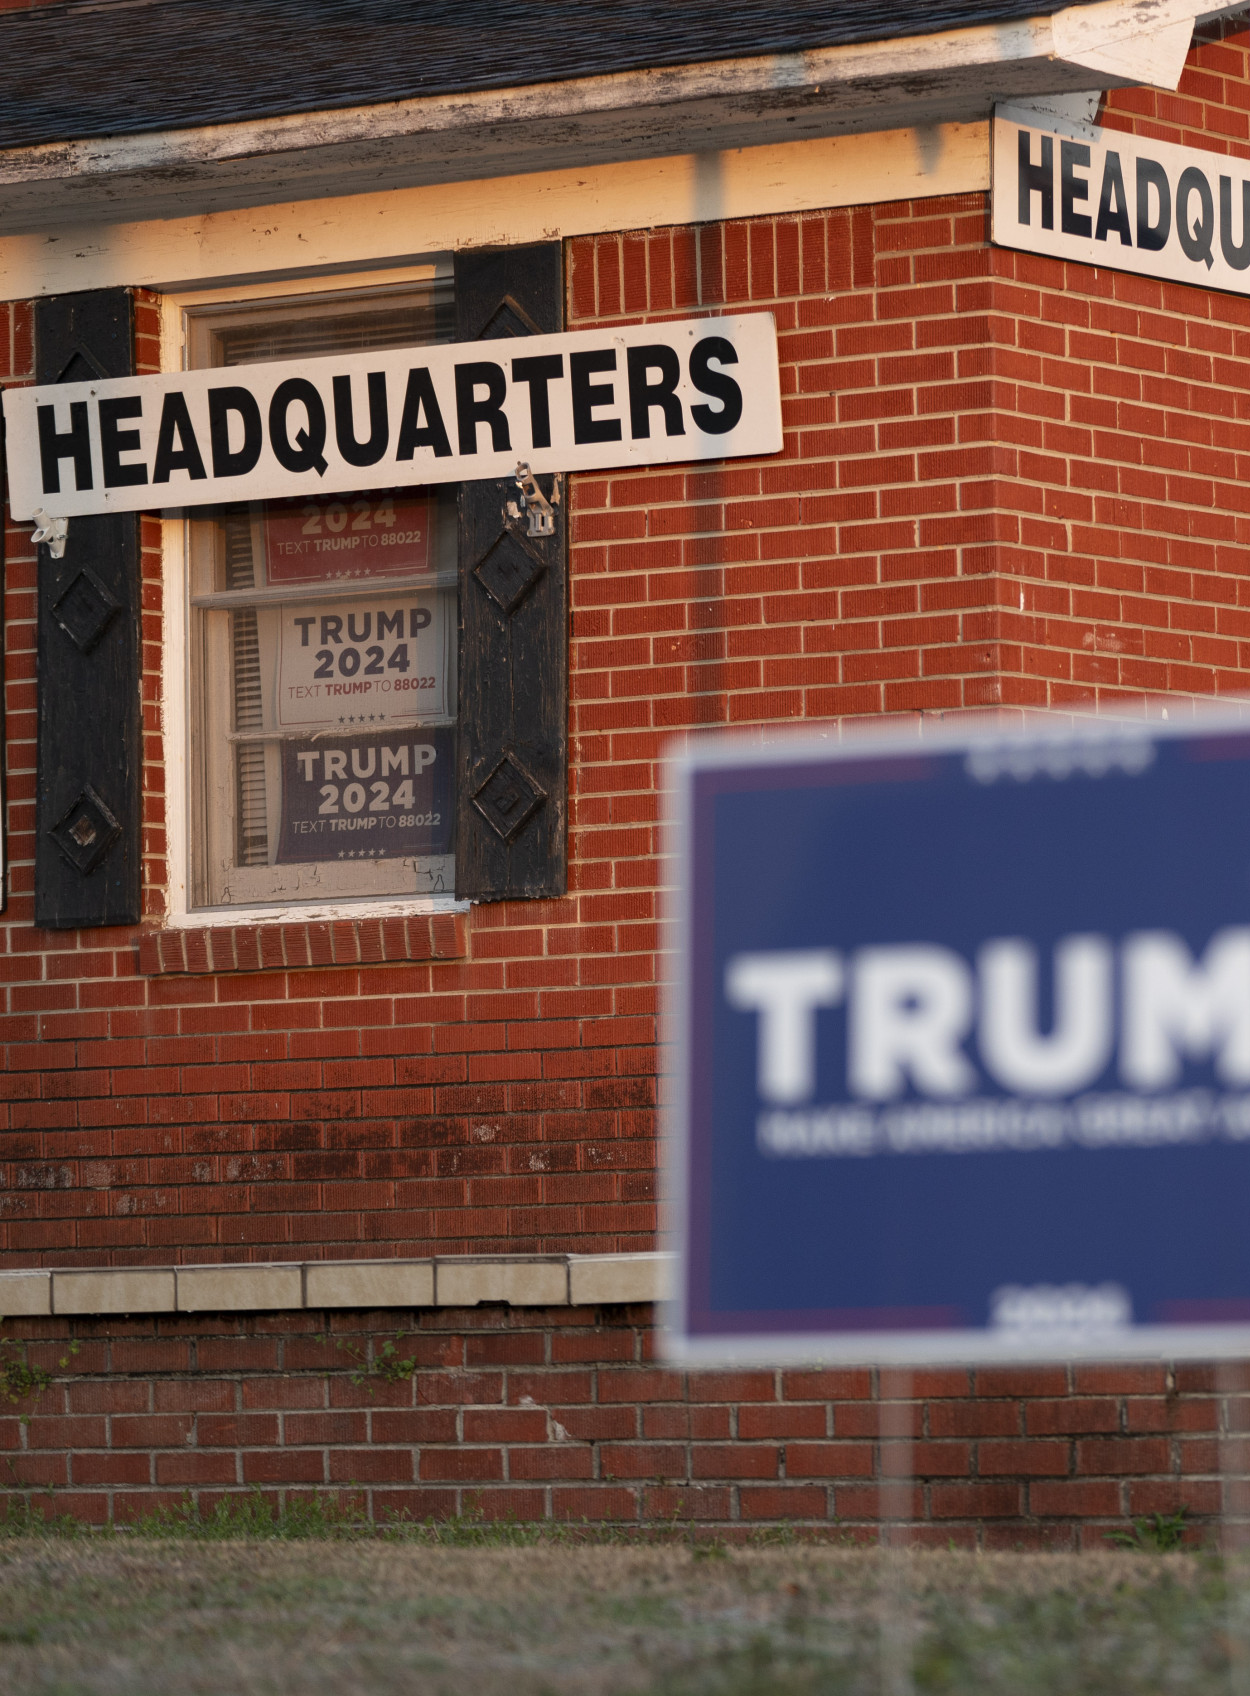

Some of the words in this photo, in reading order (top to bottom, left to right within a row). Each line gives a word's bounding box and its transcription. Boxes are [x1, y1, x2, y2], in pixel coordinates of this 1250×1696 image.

[37, 336, 743, 494] HEADQUARTERS
[301, 497, 397, 535] 2024
[277, 540, 311, 555] TEXT
[314, 536, 361, 552] TRUMP
[361, 534, 379, 549] TO
[381, 530, 421, 546] 88022
[293, 607, 432, 647] TRUMP
[313, 643, 411, 679] 2024
[287, 684, 322, 699] TEXT
[325, 681, 372, 697] TRUMP
[373, 679, 392, 693] TO
[393, 676, 436, 692] 88022
[297, 744, 437, 782] TRUMP
[318, 779, 416, 815] 2024
[292, 819, 327, 834] TEXT
[329, 816, 377, 832] TRUMP
[378, 815, 397, 829] TO
[398, 813, 441, 828] 88022
